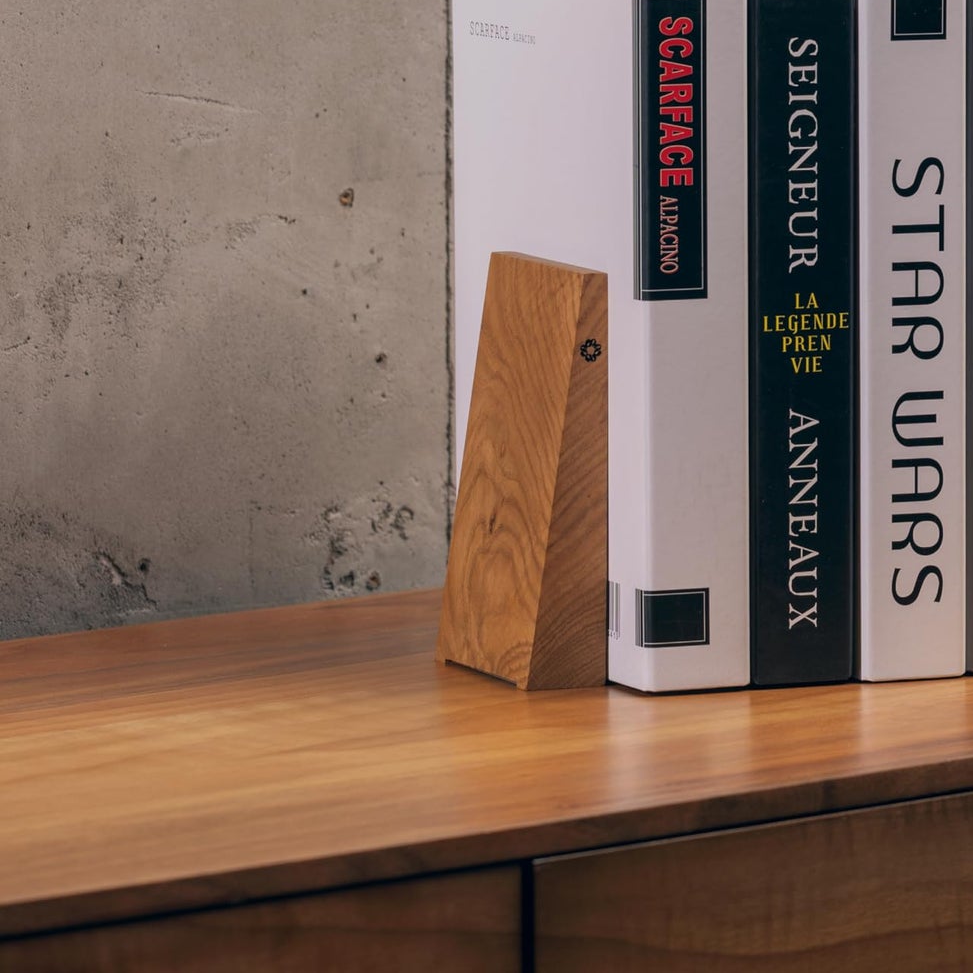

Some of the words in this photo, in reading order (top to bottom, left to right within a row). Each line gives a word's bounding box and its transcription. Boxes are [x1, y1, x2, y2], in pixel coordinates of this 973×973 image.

[470, 21, 510, 40] SCARFACE
[658, 16, 694, 188] SCARFACE
[788, 36, 819, 273] SEIGNEUR
[659, 195, 679, 274] ALPACINO
[891, 156, 945, 361] STAR
[762, 312, 850, 335] LEGENDE
[794, 292, 819, 310] LA
[781, 334, 832, 353] PREN
[790, 356, 823, 374] VIE
[788, 408, 820, 630] ANNEAUX
[891, 390, 945, 606] WARS
